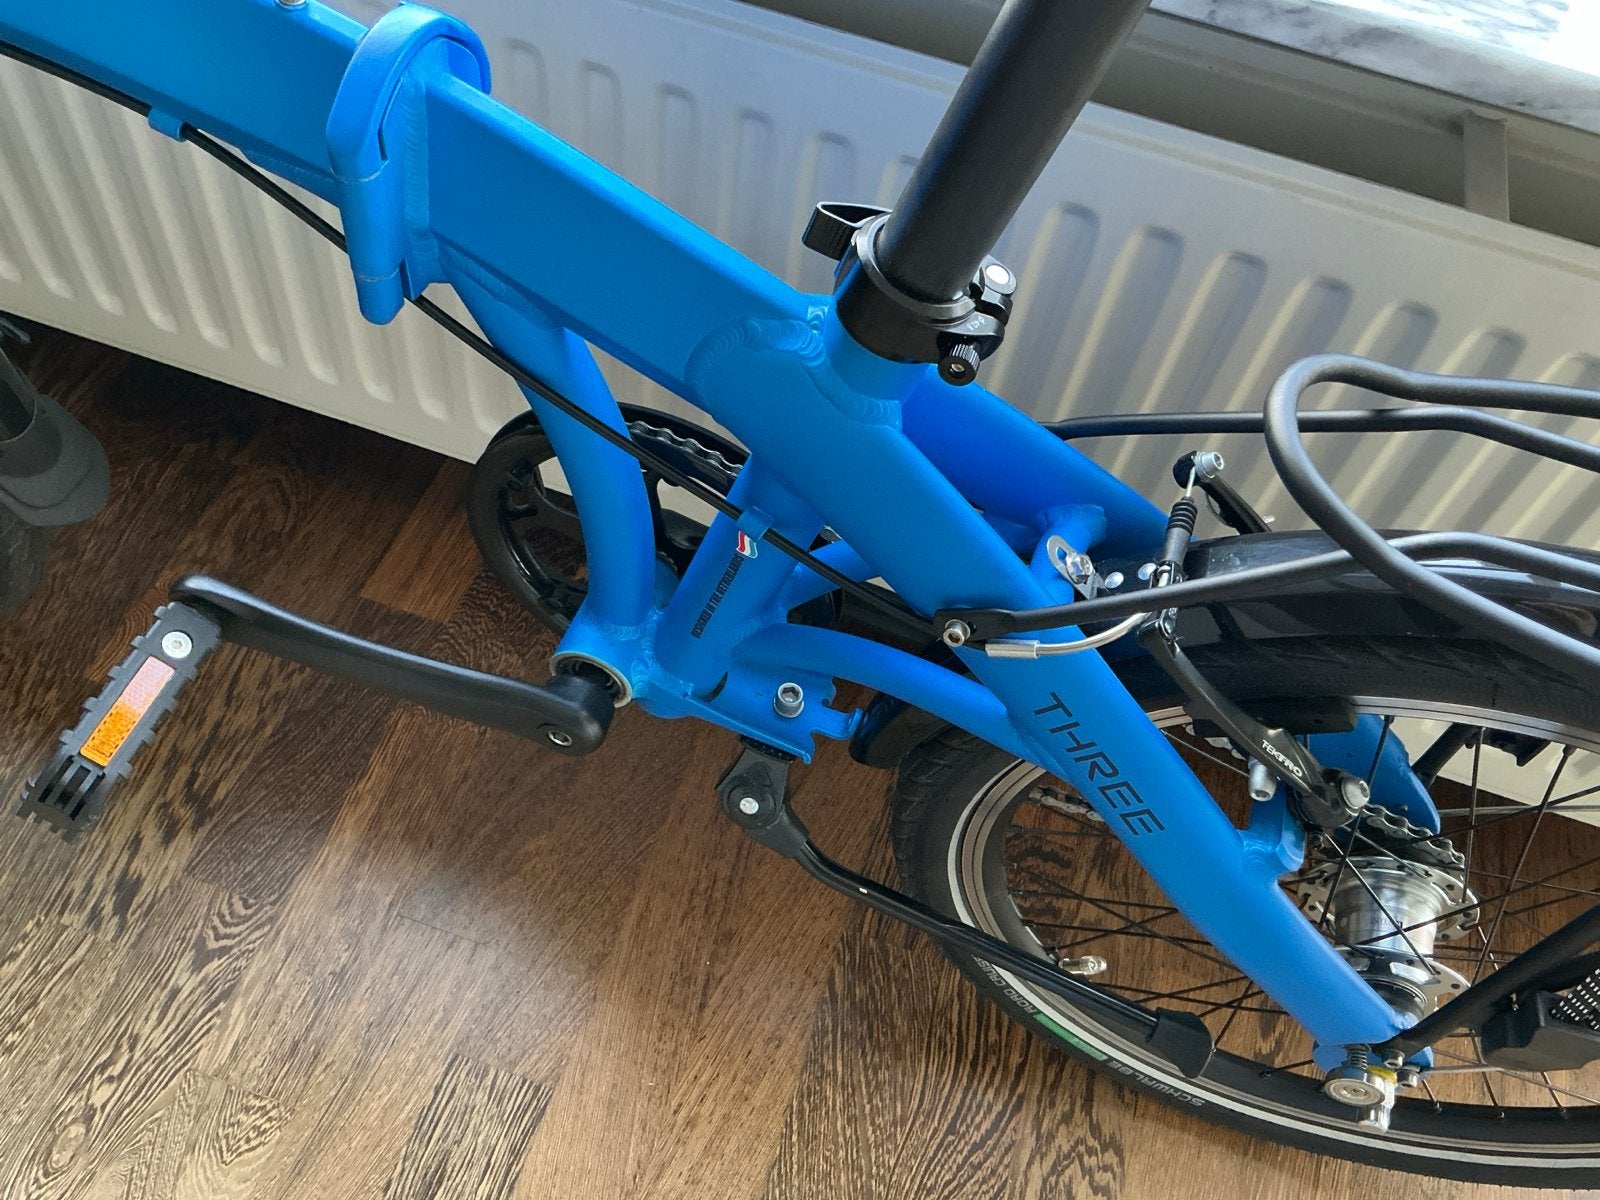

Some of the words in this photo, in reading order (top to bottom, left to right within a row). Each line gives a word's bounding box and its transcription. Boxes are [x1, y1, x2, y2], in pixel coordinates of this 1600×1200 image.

[1033, 691, 1165, 836] THREE
[1262, 739, 1303, 777] TEKTRO
[1003, 988, 1037, 1014] ROAD
[1107, 1060, 1205, 1107] SCHWALBE
